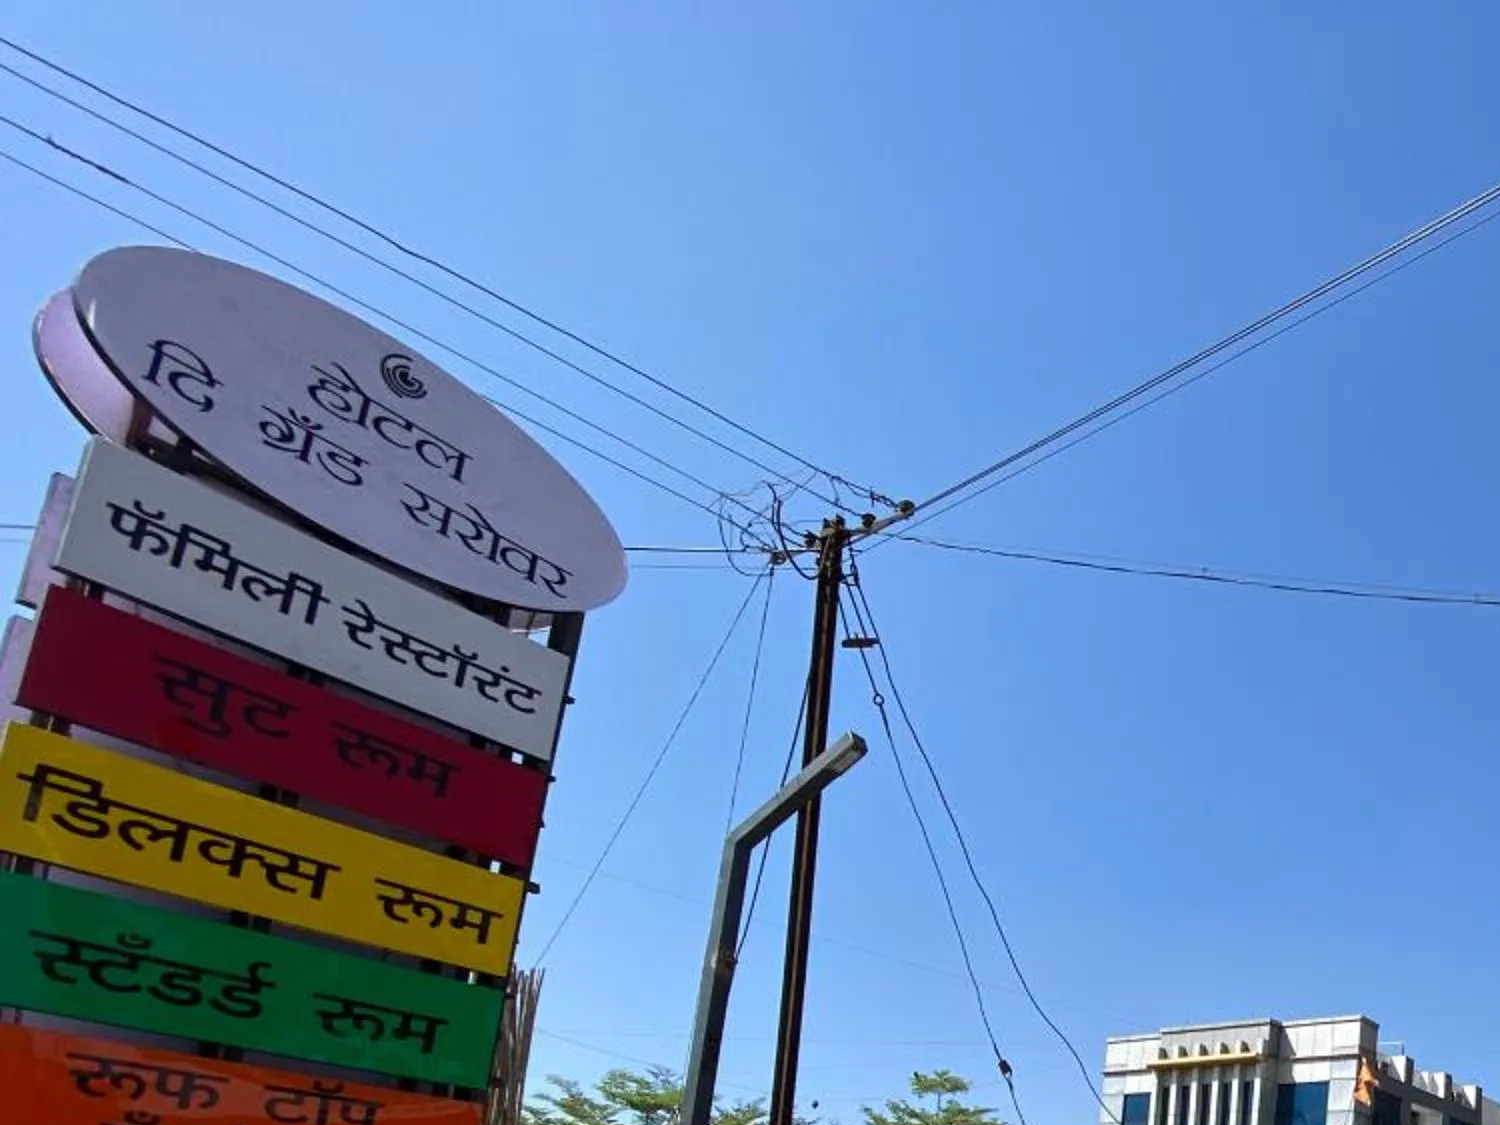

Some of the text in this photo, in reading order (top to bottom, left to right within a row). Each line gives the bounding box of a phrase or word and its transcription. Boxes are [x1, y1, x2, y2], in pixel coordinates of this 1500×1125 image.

[307, 361, 474, 484] होटल
[400, 481, 575, 599] सरोवर
[106, 499, 542, 714] फॅमिली रेस्टॉरंट
[157, 655, 460, 798] सुट रूम
[16, 763, 504, 945] डिलक्स रूम
[67, 1052, 230, 1110] रूफ
[313, 992, 450, 1054] रूम
